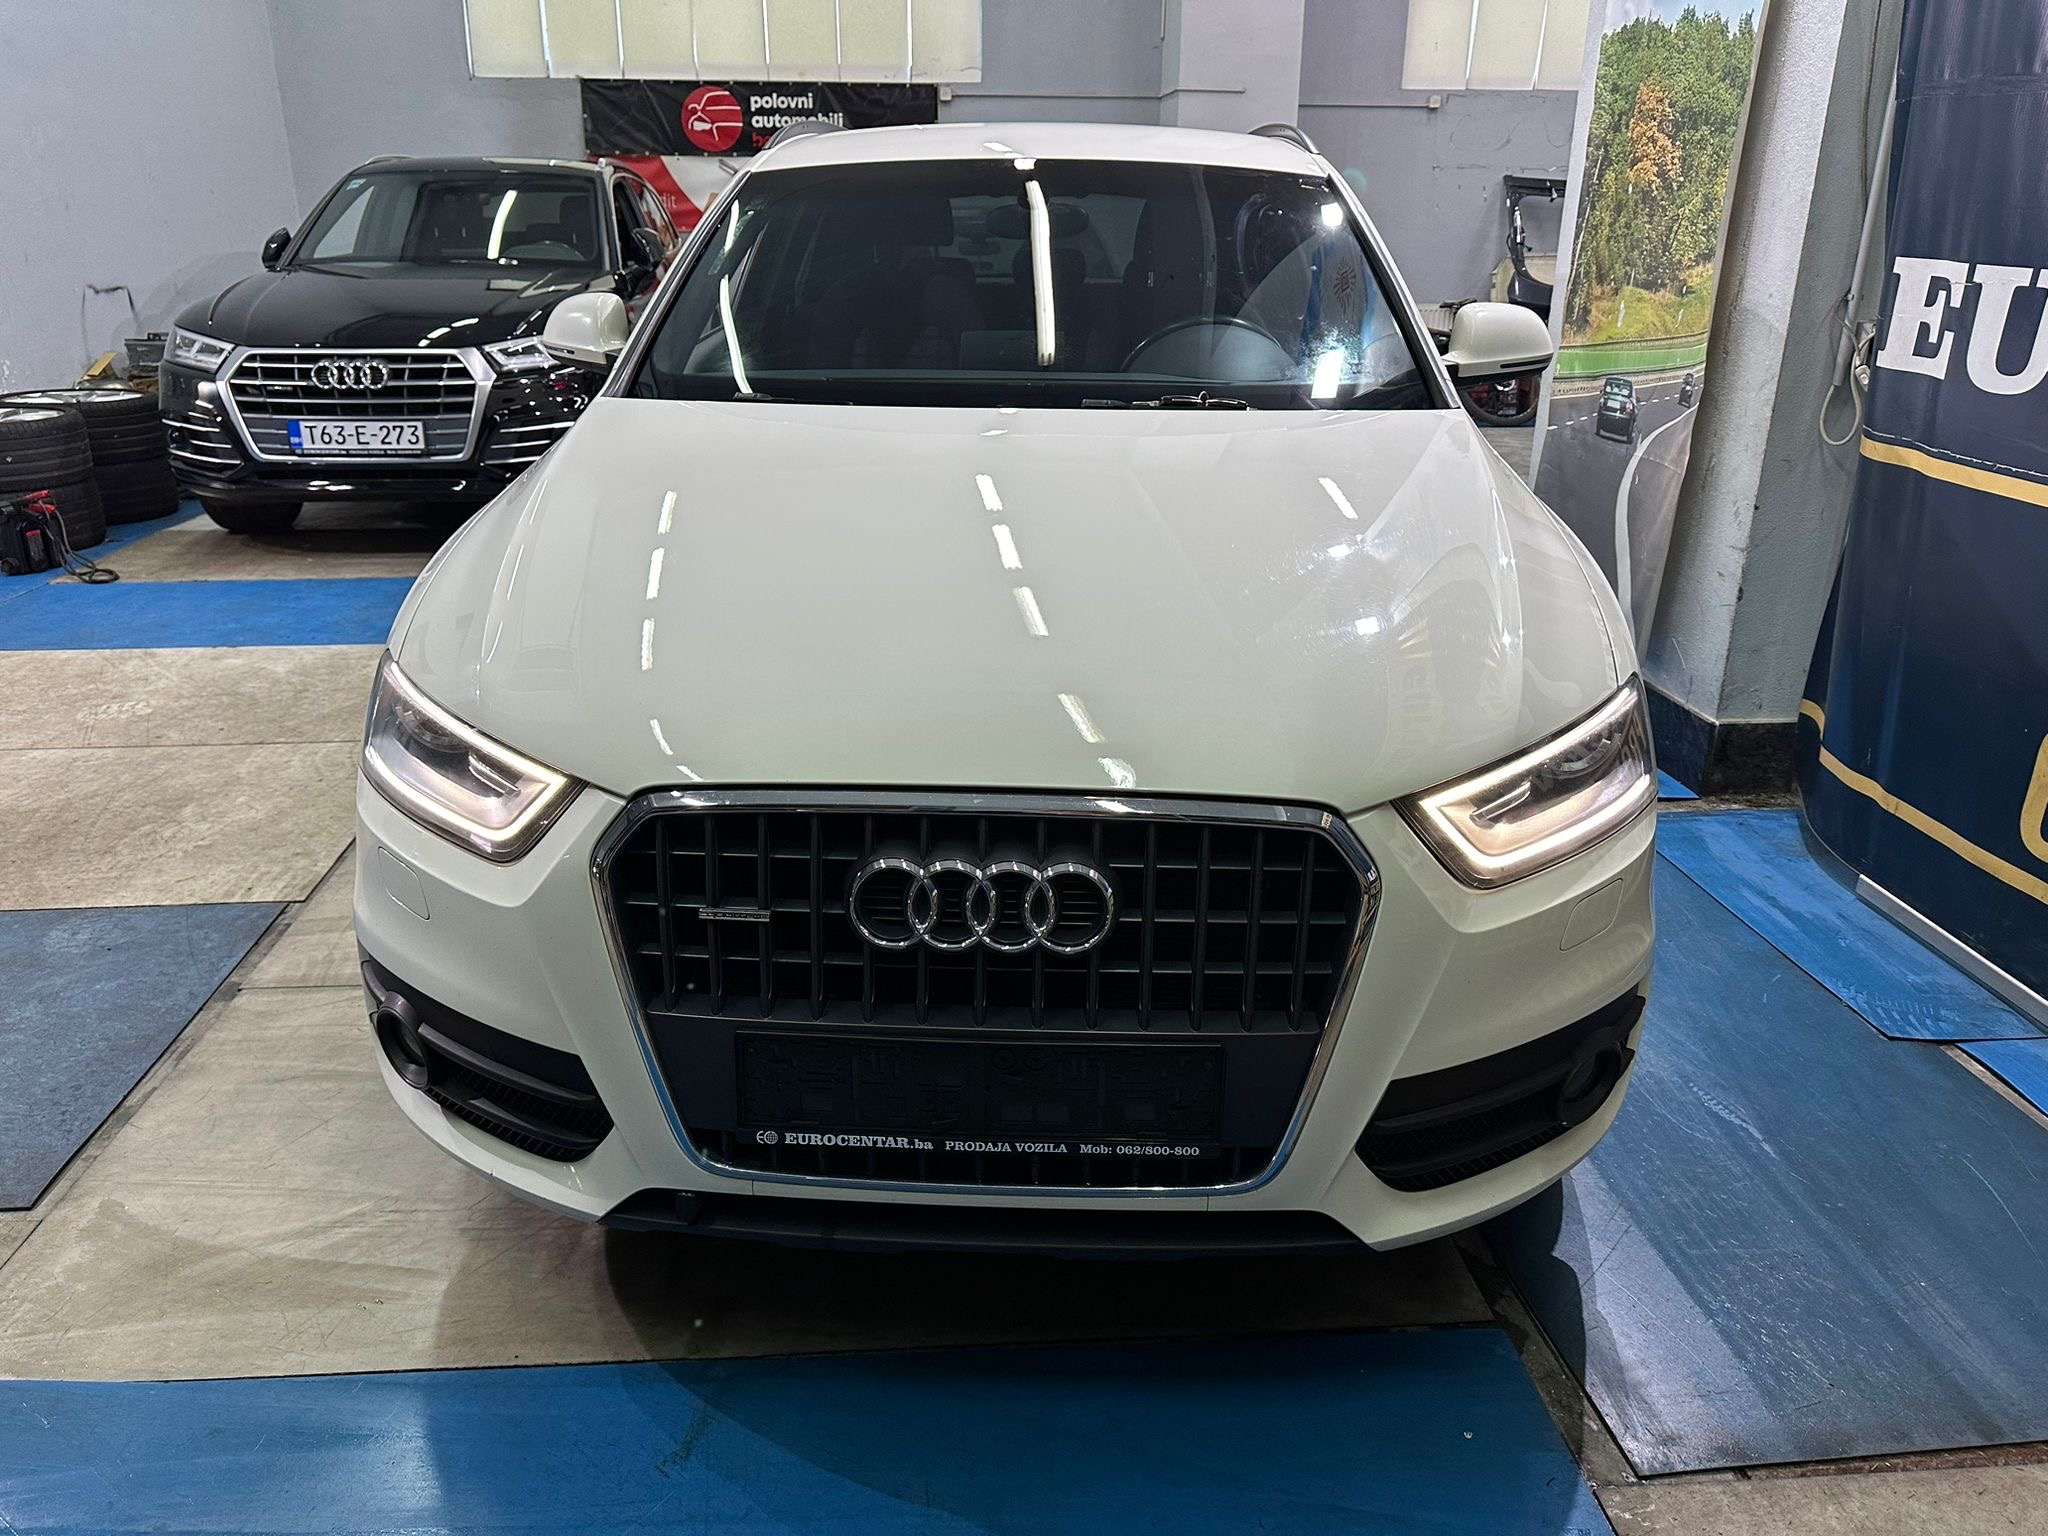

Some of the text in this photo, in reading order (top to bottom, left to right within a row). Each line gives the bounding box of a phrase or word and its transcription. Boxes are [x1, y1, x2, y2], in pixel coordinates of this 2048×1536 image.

[749, 92, 814, 112] polovni
[1876, 256, 2048, 395] EU
[304, 424, 419, 446] T63-E-273
[784, 1132, 934, 1150] EUROCENTAR.ba
[945, 1140, 1012, 1152] PRODAJA
[1015, 1142, 1068, 1154] VOZILA
[1080, 1143, 1113, 1155] Mob:
[1116, 1144, 1200, 1157] 062/800-800
